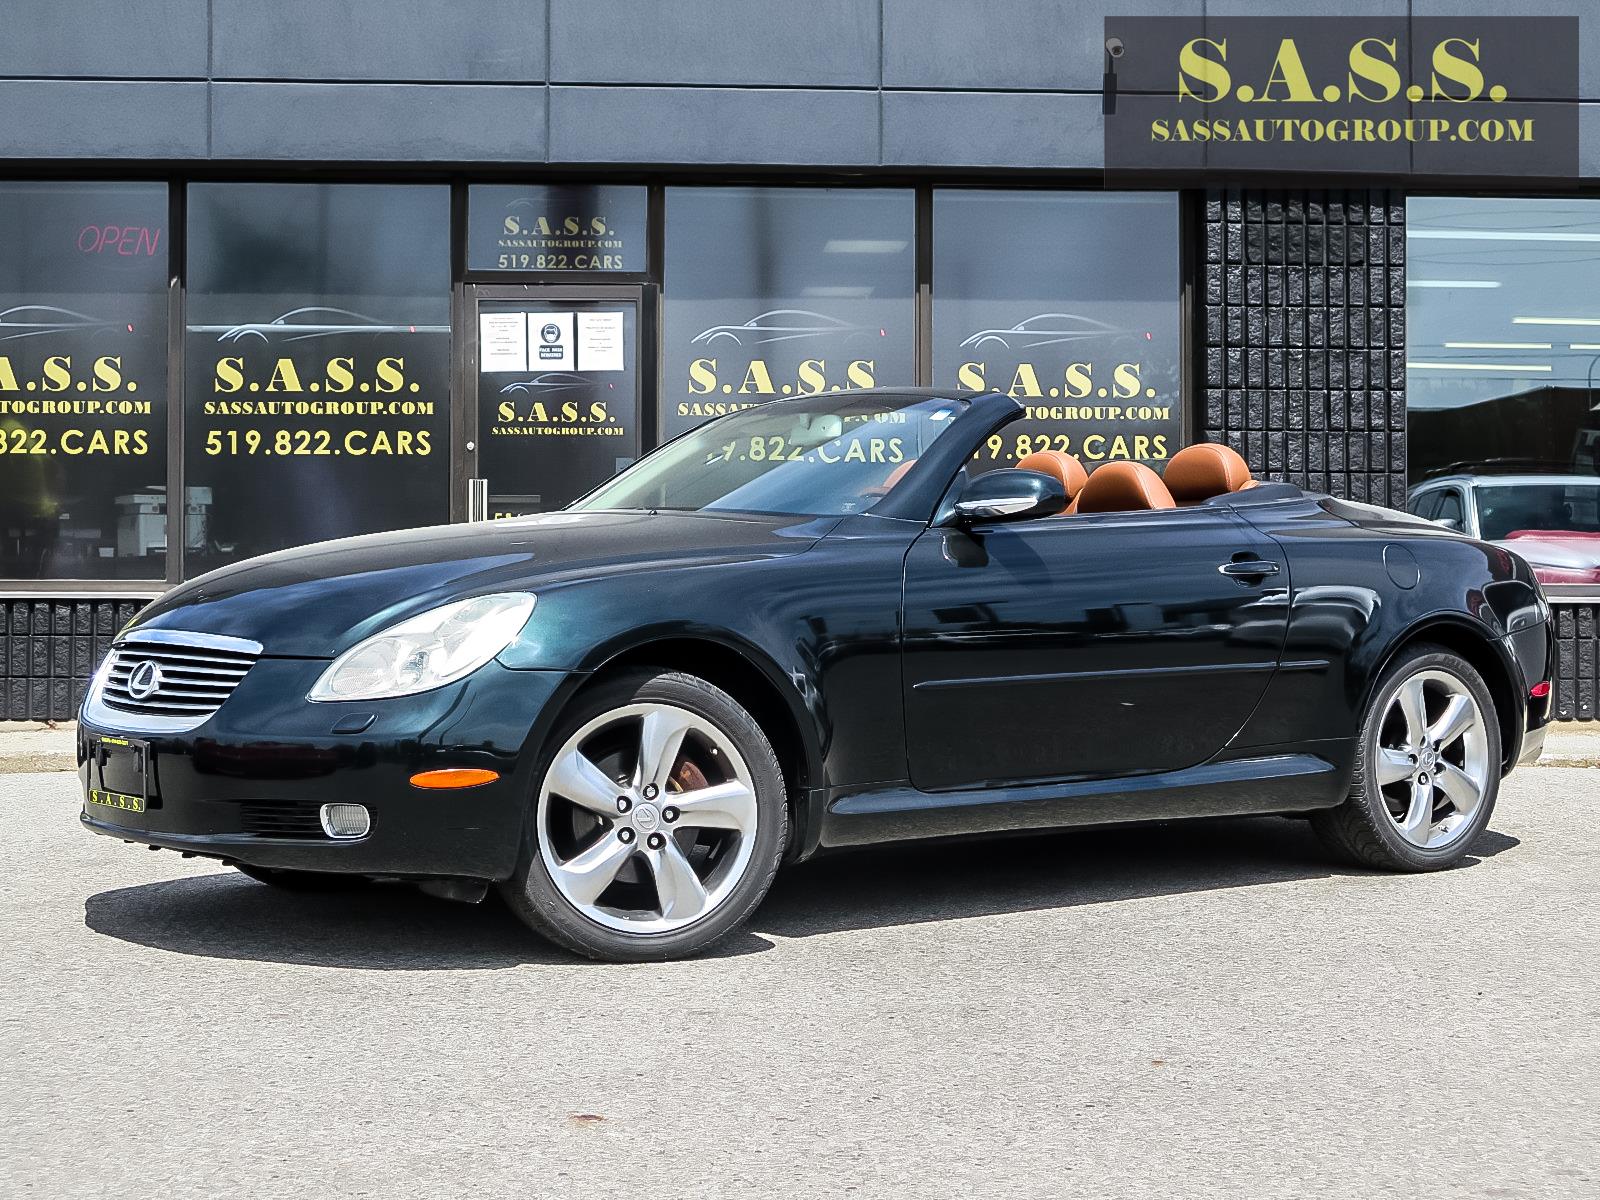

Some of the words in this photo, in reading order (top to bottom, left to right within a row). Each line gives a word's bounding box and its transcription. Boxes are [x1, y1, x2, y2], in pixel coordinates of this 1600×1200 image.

[503, 215, 615, 236] S.A.S.S.
[78, 225, 160, 256] OPEN
[498, 239, 623, 248] SASSAUTOGROUP.COM
[498, 254, 623, 269] 519.822.CARS
[214, 357, 420, 393] S.A.S.S.
[203, 401, 434, 415] SASSAUTOGROUP.COM
[498, 401, 616, 422] S.A.S.S.
[1025, 406, 1170, 420] TOGROUP.COM
[492, 427, 624, 436] SASSAUTOGROUP.COM
[205, 429, 431, 455] 519.822.CARS
[92, 790, 141, 810] S.A.S.S.
